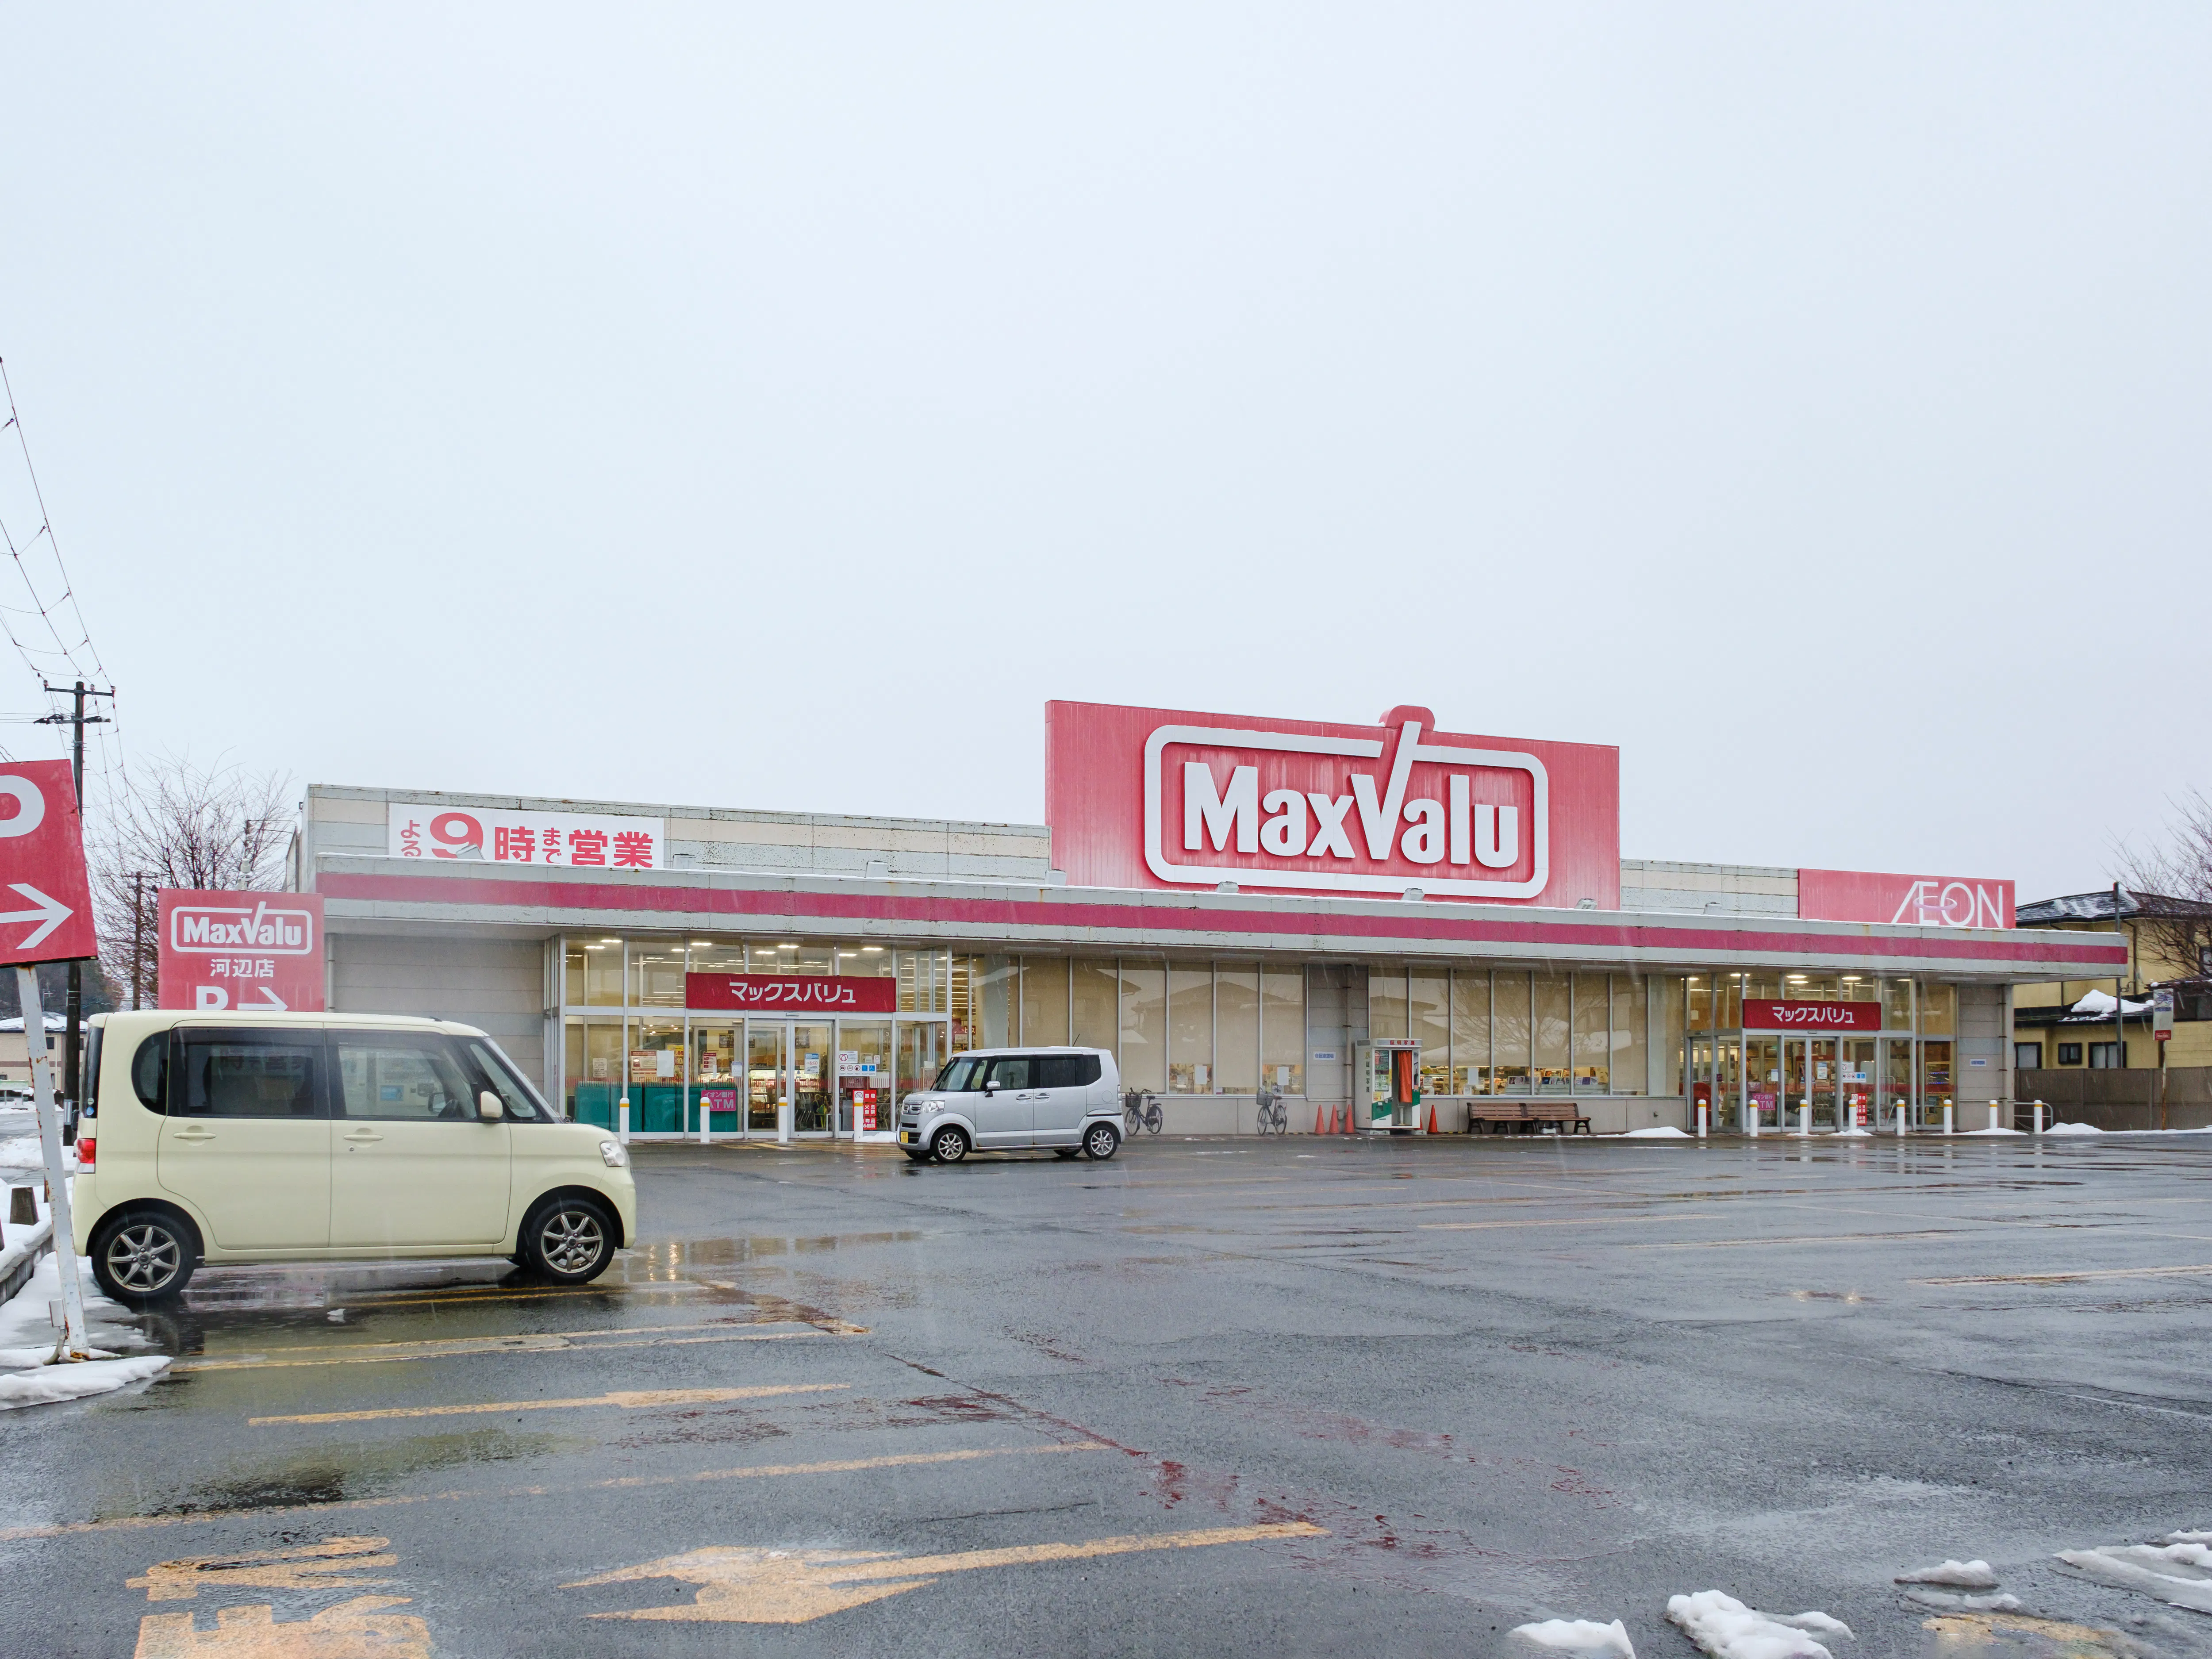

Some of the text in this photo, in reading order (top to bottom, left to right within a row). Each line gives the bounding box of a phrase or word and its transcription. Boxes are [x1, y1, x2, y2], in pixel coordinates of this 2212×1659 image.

[1184, 721, 1518, 868] MaxValu
[184, 901, 302, 945] MaxValu
[210, 958, 275, 978] 河辺店
[729, 982, 856, 1003] マックスバリュ
[1772, 1006, 1855, 1024] マックスバリュ
